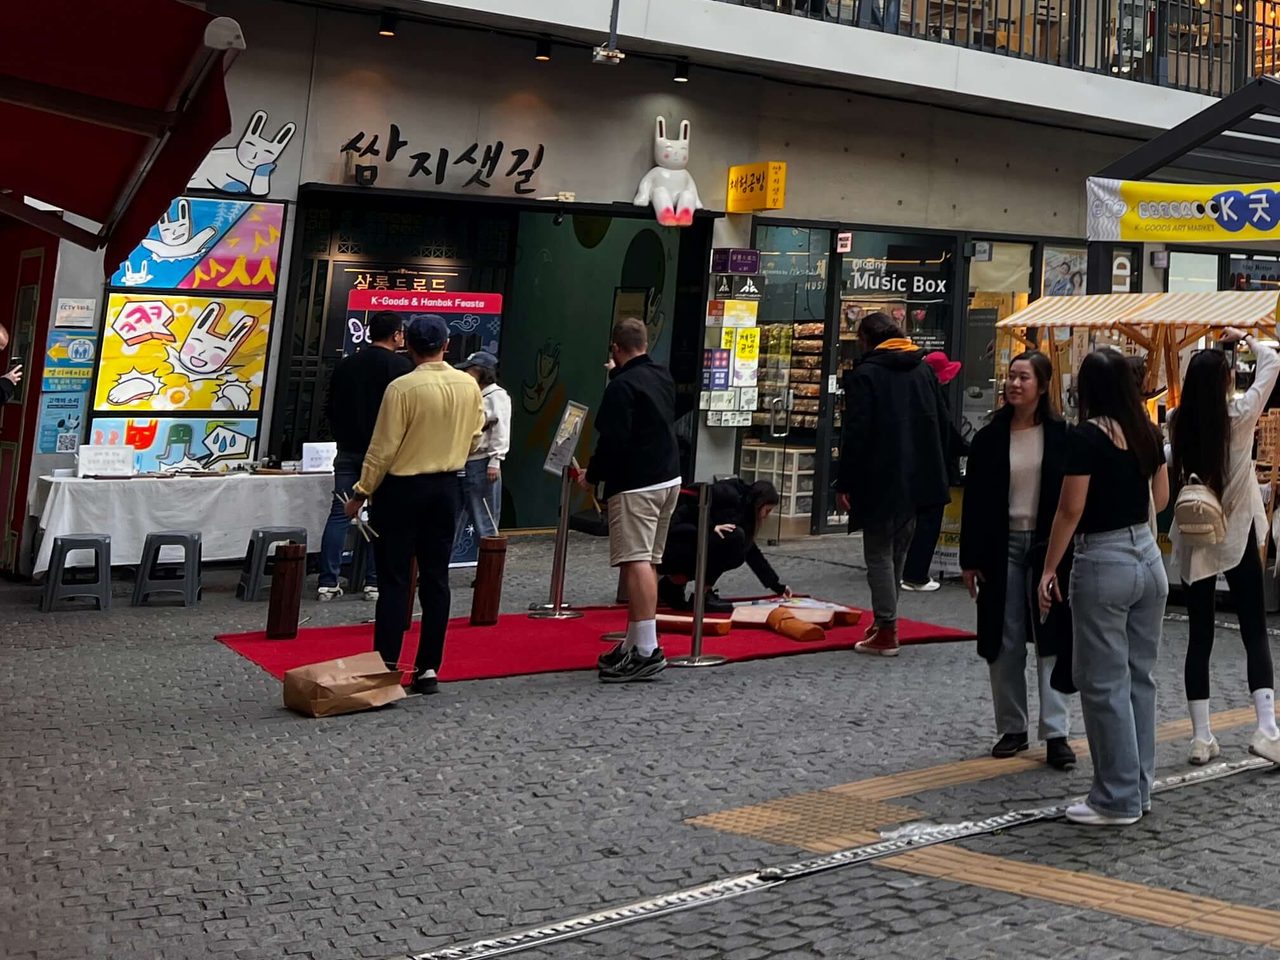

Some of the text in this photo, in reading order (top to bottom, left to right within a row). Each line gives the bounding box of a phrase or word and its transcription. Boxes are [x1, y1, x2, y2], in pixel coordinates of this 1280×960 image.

[853, 271, 947, 294] Music Box
[371, 296, 485, 309] K-Goods & Hanbok Feasta
